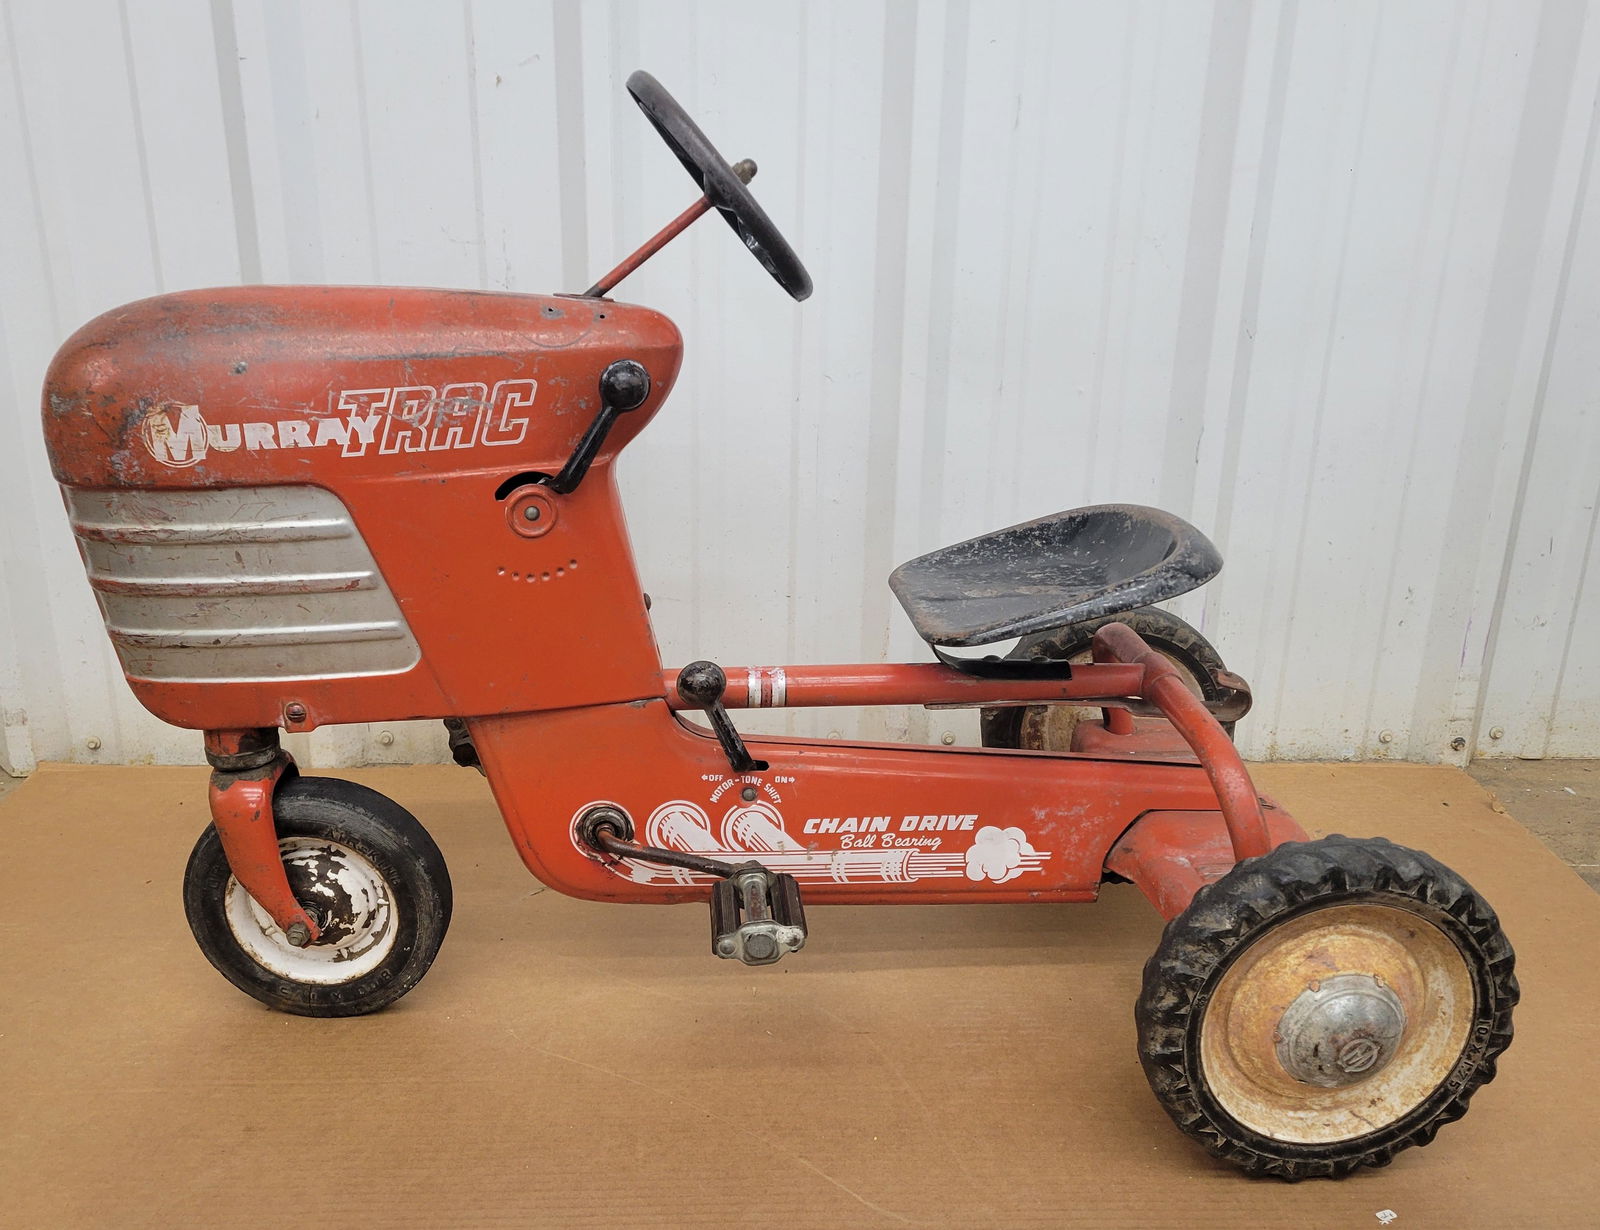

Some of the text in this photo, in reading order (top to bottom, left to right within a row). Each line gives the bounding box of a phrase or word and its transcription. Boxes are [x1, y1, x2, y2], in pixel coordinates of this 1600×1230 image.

[337, 379, 538, 458] TRAC
[708, 774, 788, 784] OFF ON
[763, 783, 782, 804] SHIFT
[803, 814, 978, 834] CHAIN DRIVE
[840, 832, 942, 851] Ball Bearing
